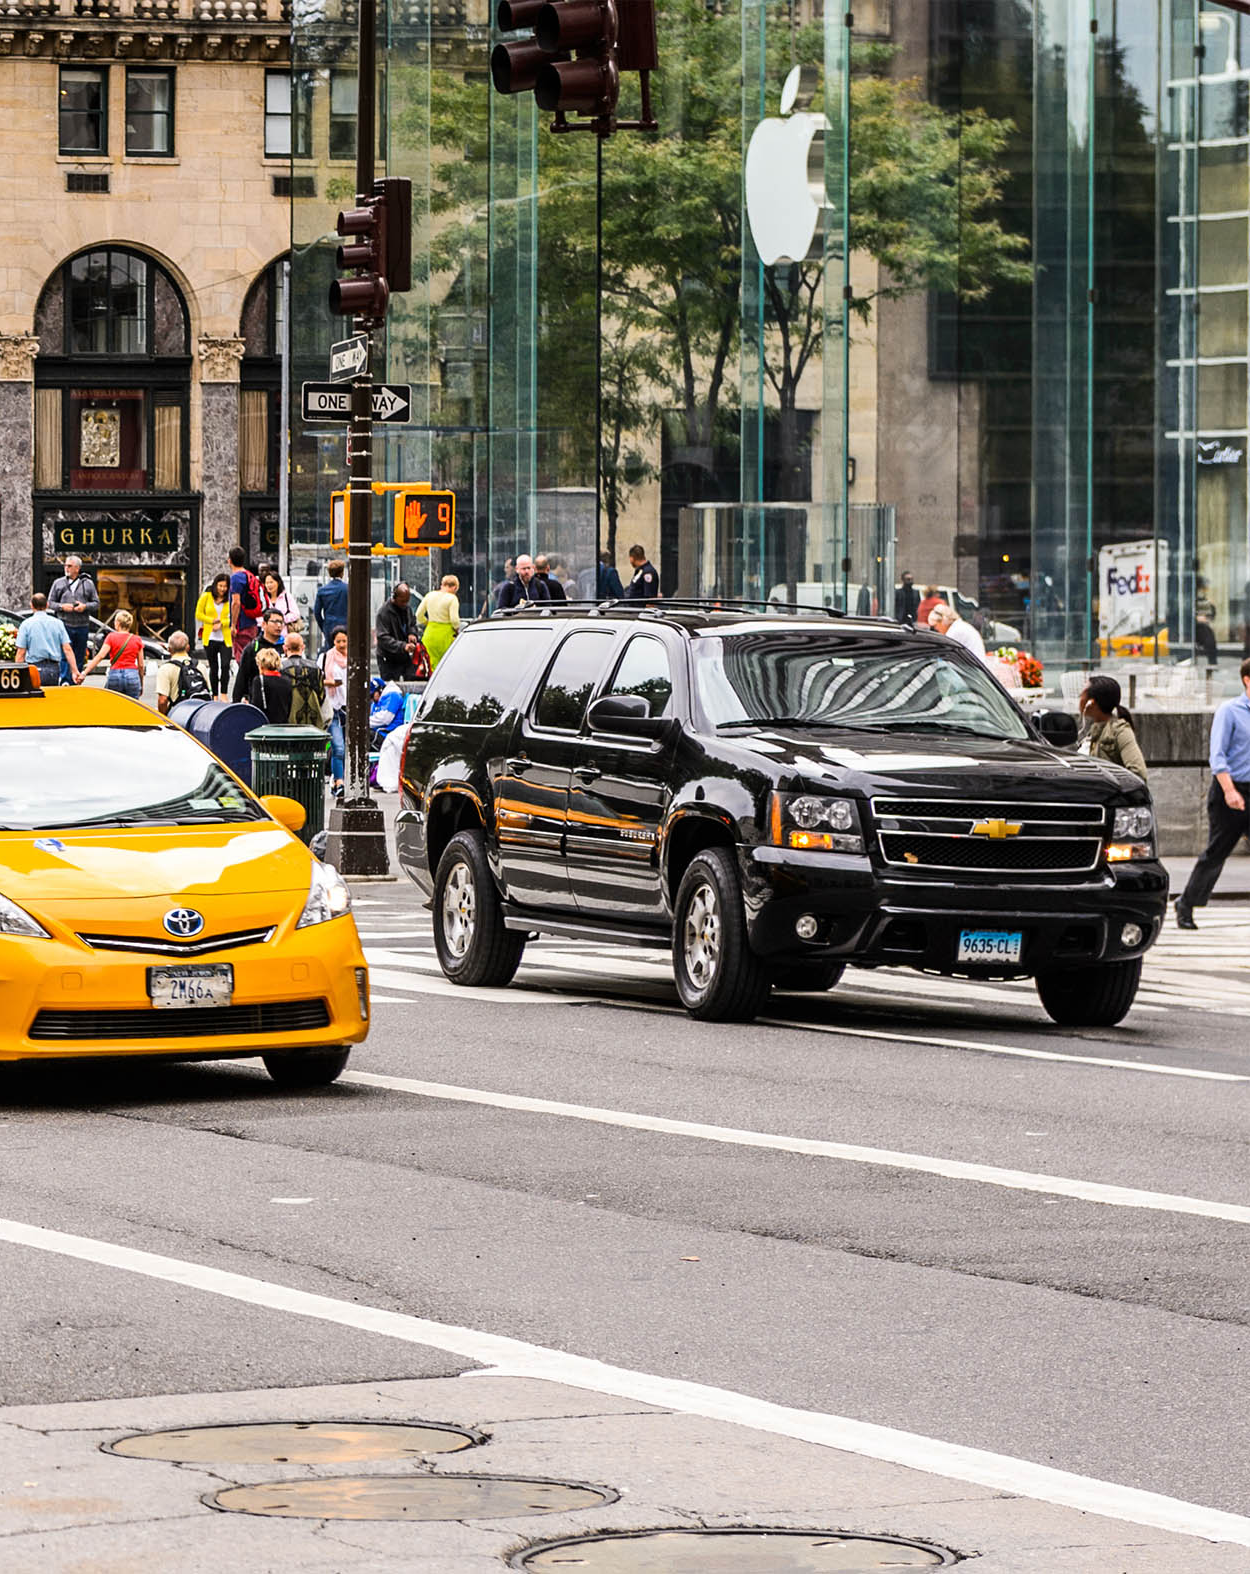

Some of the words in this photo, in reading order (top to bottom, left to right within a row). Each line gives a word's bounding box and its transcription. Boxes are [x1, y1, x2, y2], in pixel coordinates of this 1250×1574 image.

[335, 354, 346, 370] ONE
[318, 394, 347, 410] ONE
[437, 503, 450, 536] 9
[60, 528, 172, 545] GHURKA
[1107, 564, 1150, 595] FedEx
